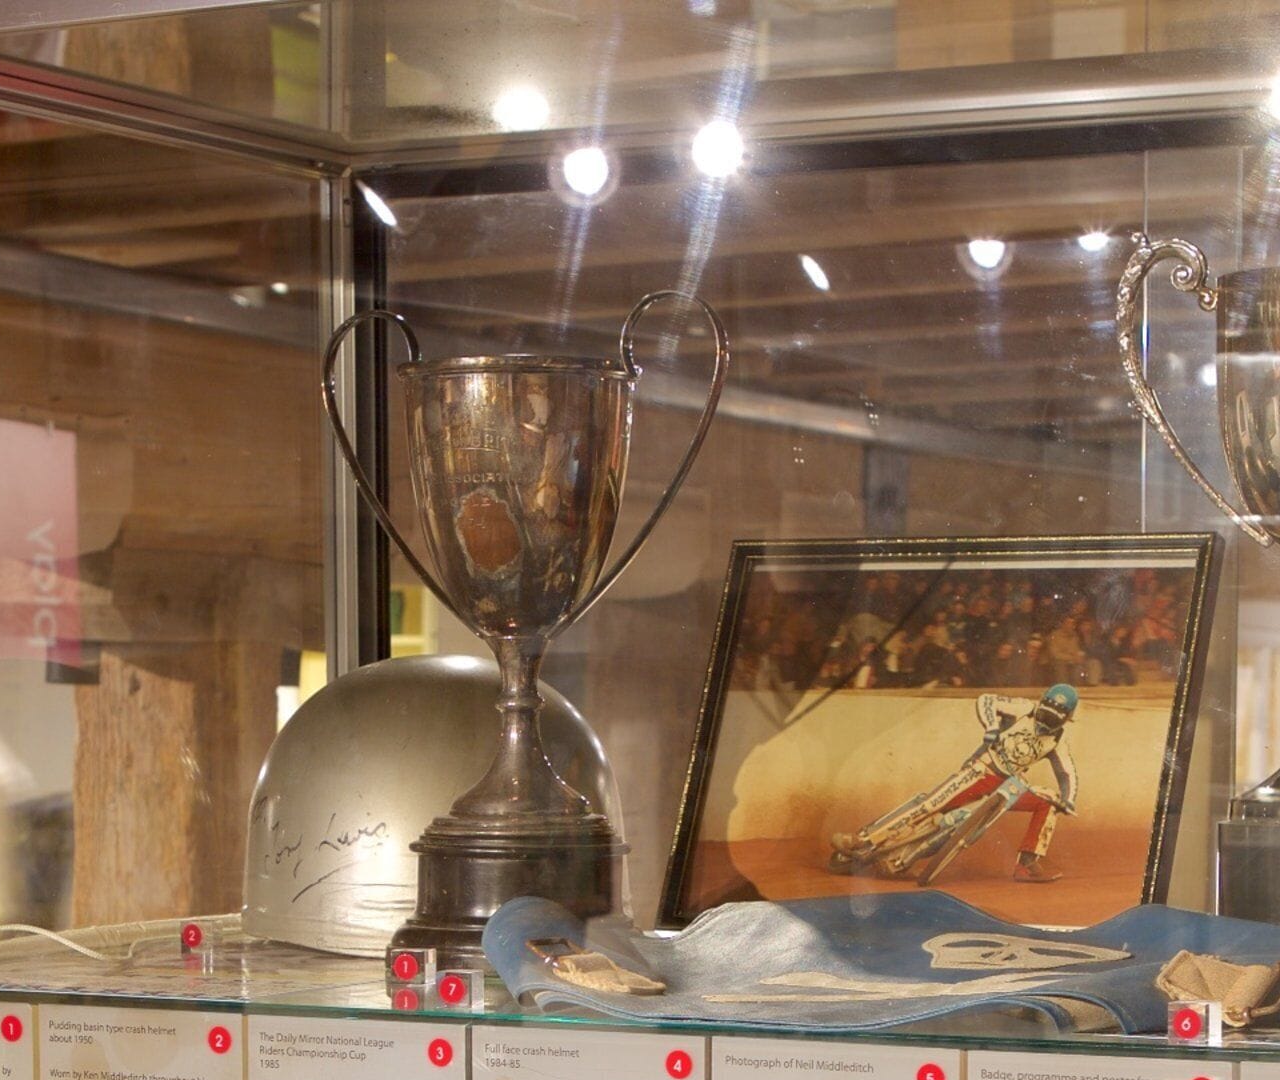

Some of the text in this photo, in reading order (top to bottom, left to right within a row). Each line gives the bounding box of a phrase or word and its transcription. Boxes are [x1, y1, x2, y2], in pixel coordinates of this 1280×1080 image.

[188, 930, 196, 941] 2
[402, 961, 408, 972] 1
[448, 984, 457, 996] 7
[8, 1023, 14, 1036] 1
[1181, 1016, 1192, 1031] 6
[259, 1032, 395, 1051] The Daily Mirror National League
[259, 1045, 367, 1063] Riders Championship Cup
[435, 1046, 445, 1060] 3
[484, 1043, 580, 1059] Full face crash helmet
[259, 1059, 281, 1070] 1985
[484, 1057, 522, 1069] 1984-85
[673, 1058, 683, 1073] 4
[724, 1055, 875, 1074] Photograph of Neil Middleditch
